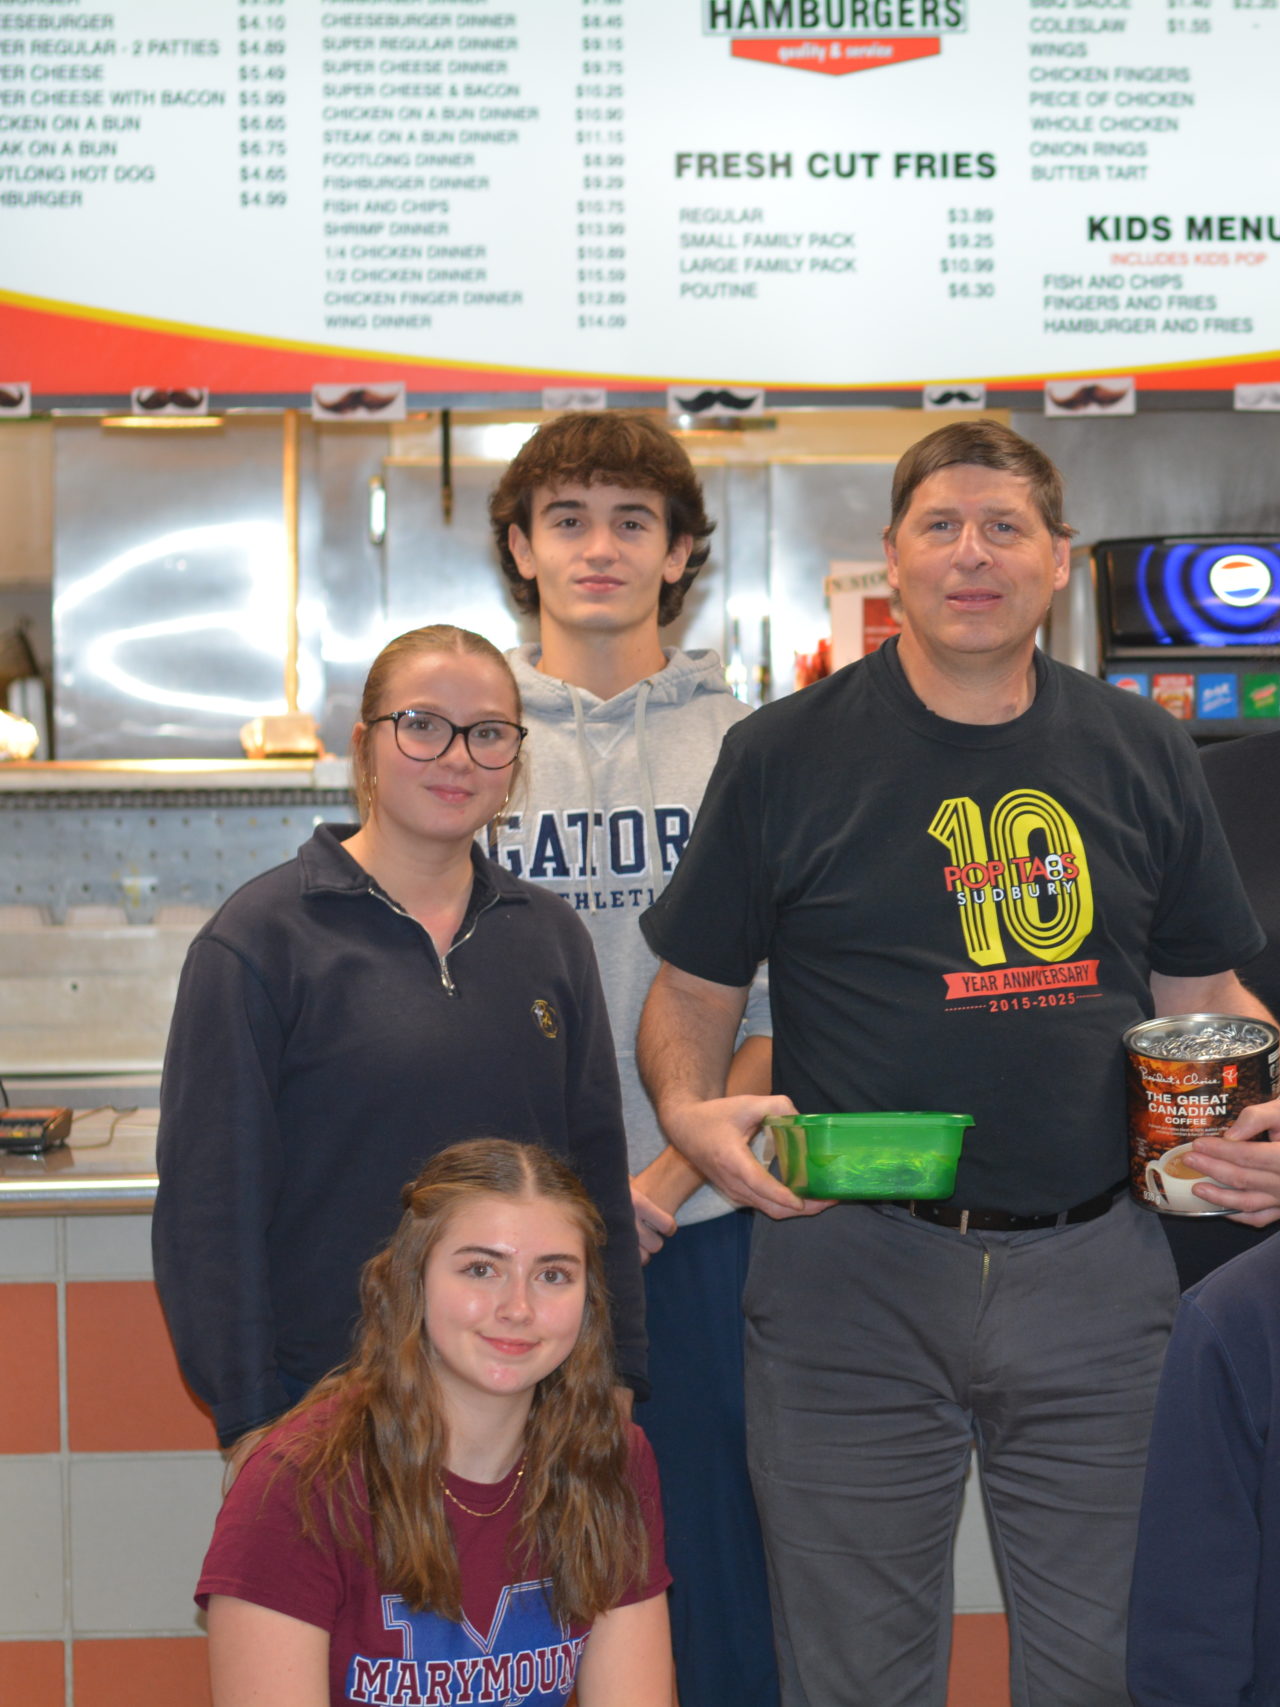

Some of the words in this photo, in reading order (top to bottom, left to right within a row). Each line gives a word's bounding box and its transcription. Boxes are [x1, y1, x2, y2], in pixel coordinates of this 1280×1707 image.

[709, 0, 963, 30] HAMBURGERS
[1029, 16, 1127, 34] COLESLAW
[1028, 41, 1088, 58] WINGS
[1029, 66, 1109, 83] CHICKEN
[1113, 66, 1191, 83] FINGERS
[1029, 91, 1081, 107] PIECE
[1085, 91, 1110, 107] OF
[1114, 91, 1195, 108] CHICKEN
[1031, 116, 1093, 132] WHOLE
[1099, 116, 1179, 132] CHICKEN
[1029, 141, 1088, 157] ONION
[1092, 141, 1148, 157] RINGS
[676, 152, 792, 178] FRESH
[807, 152, 880, 179] CUT
[894, 152, 997, 179] FRIES
[1031, 165, 1100, 182] BUTTER
[1105, 165, 1149, 181] TART
[678, 208, 764, 224] REGULAR
[948, 208, 995, 224] $3.89
[1088, 215, 1172, 242] KIDS
[680, 232, 737, 249] SMALL
[743, 232, 803, 248] FAMILY
[808, 232, 855, 248] PACK
[948, 233, 994, 249] $9.25
[679, 257, 739, 274] LARGE
[744, 257, 804, 273] FAMILY
[809, 257, 856, 273] PACK
[940, 258, 995, 274] $10.99
[1111, 252, 1189, 266] INCLUDES
[1194, 253, 1230, 266] KIDS
[1235, 252, 1267, 266] POP
[679, 282, 758, 299] POUTINE
[948, 282, 995, 299] $6.30
[1043, 274, 1083, 291] FISH
[1087, 274, 1125, 290] AND
[1129, 273, 1184, 290] CHIPS
[1043, 295, 1120, 312] FINGERS
[1124, 295, 1163, 311] AND
[1167, 295, 1217, 311] FRIES
[1044, 318, 1157, 334] HAMBURGER
[1161, 317, 1199, 334] AND
[1203, 317, 1254, 334] FRIES
[927, 788, 1094, 966] 10
[944, 860, 1005, 891] POP
[957, 881, 1074, 905] SUDBURY
[961, 974, 997, 993] YEAR
[1003, 964, 1090, 989] ANNIVERSARY
[989, 992, 1077, 1013] 2015-2025
[1146, 1090, 1172, 1104] THE
[1177, 1093, 1229, 1105] GREAT
[1148, 1102, 1227, 1116] CANADIAN
[1164, 1116, 1208, 1125] COFFEE
[350, 1631, 593, 1706] MARYMOUN
